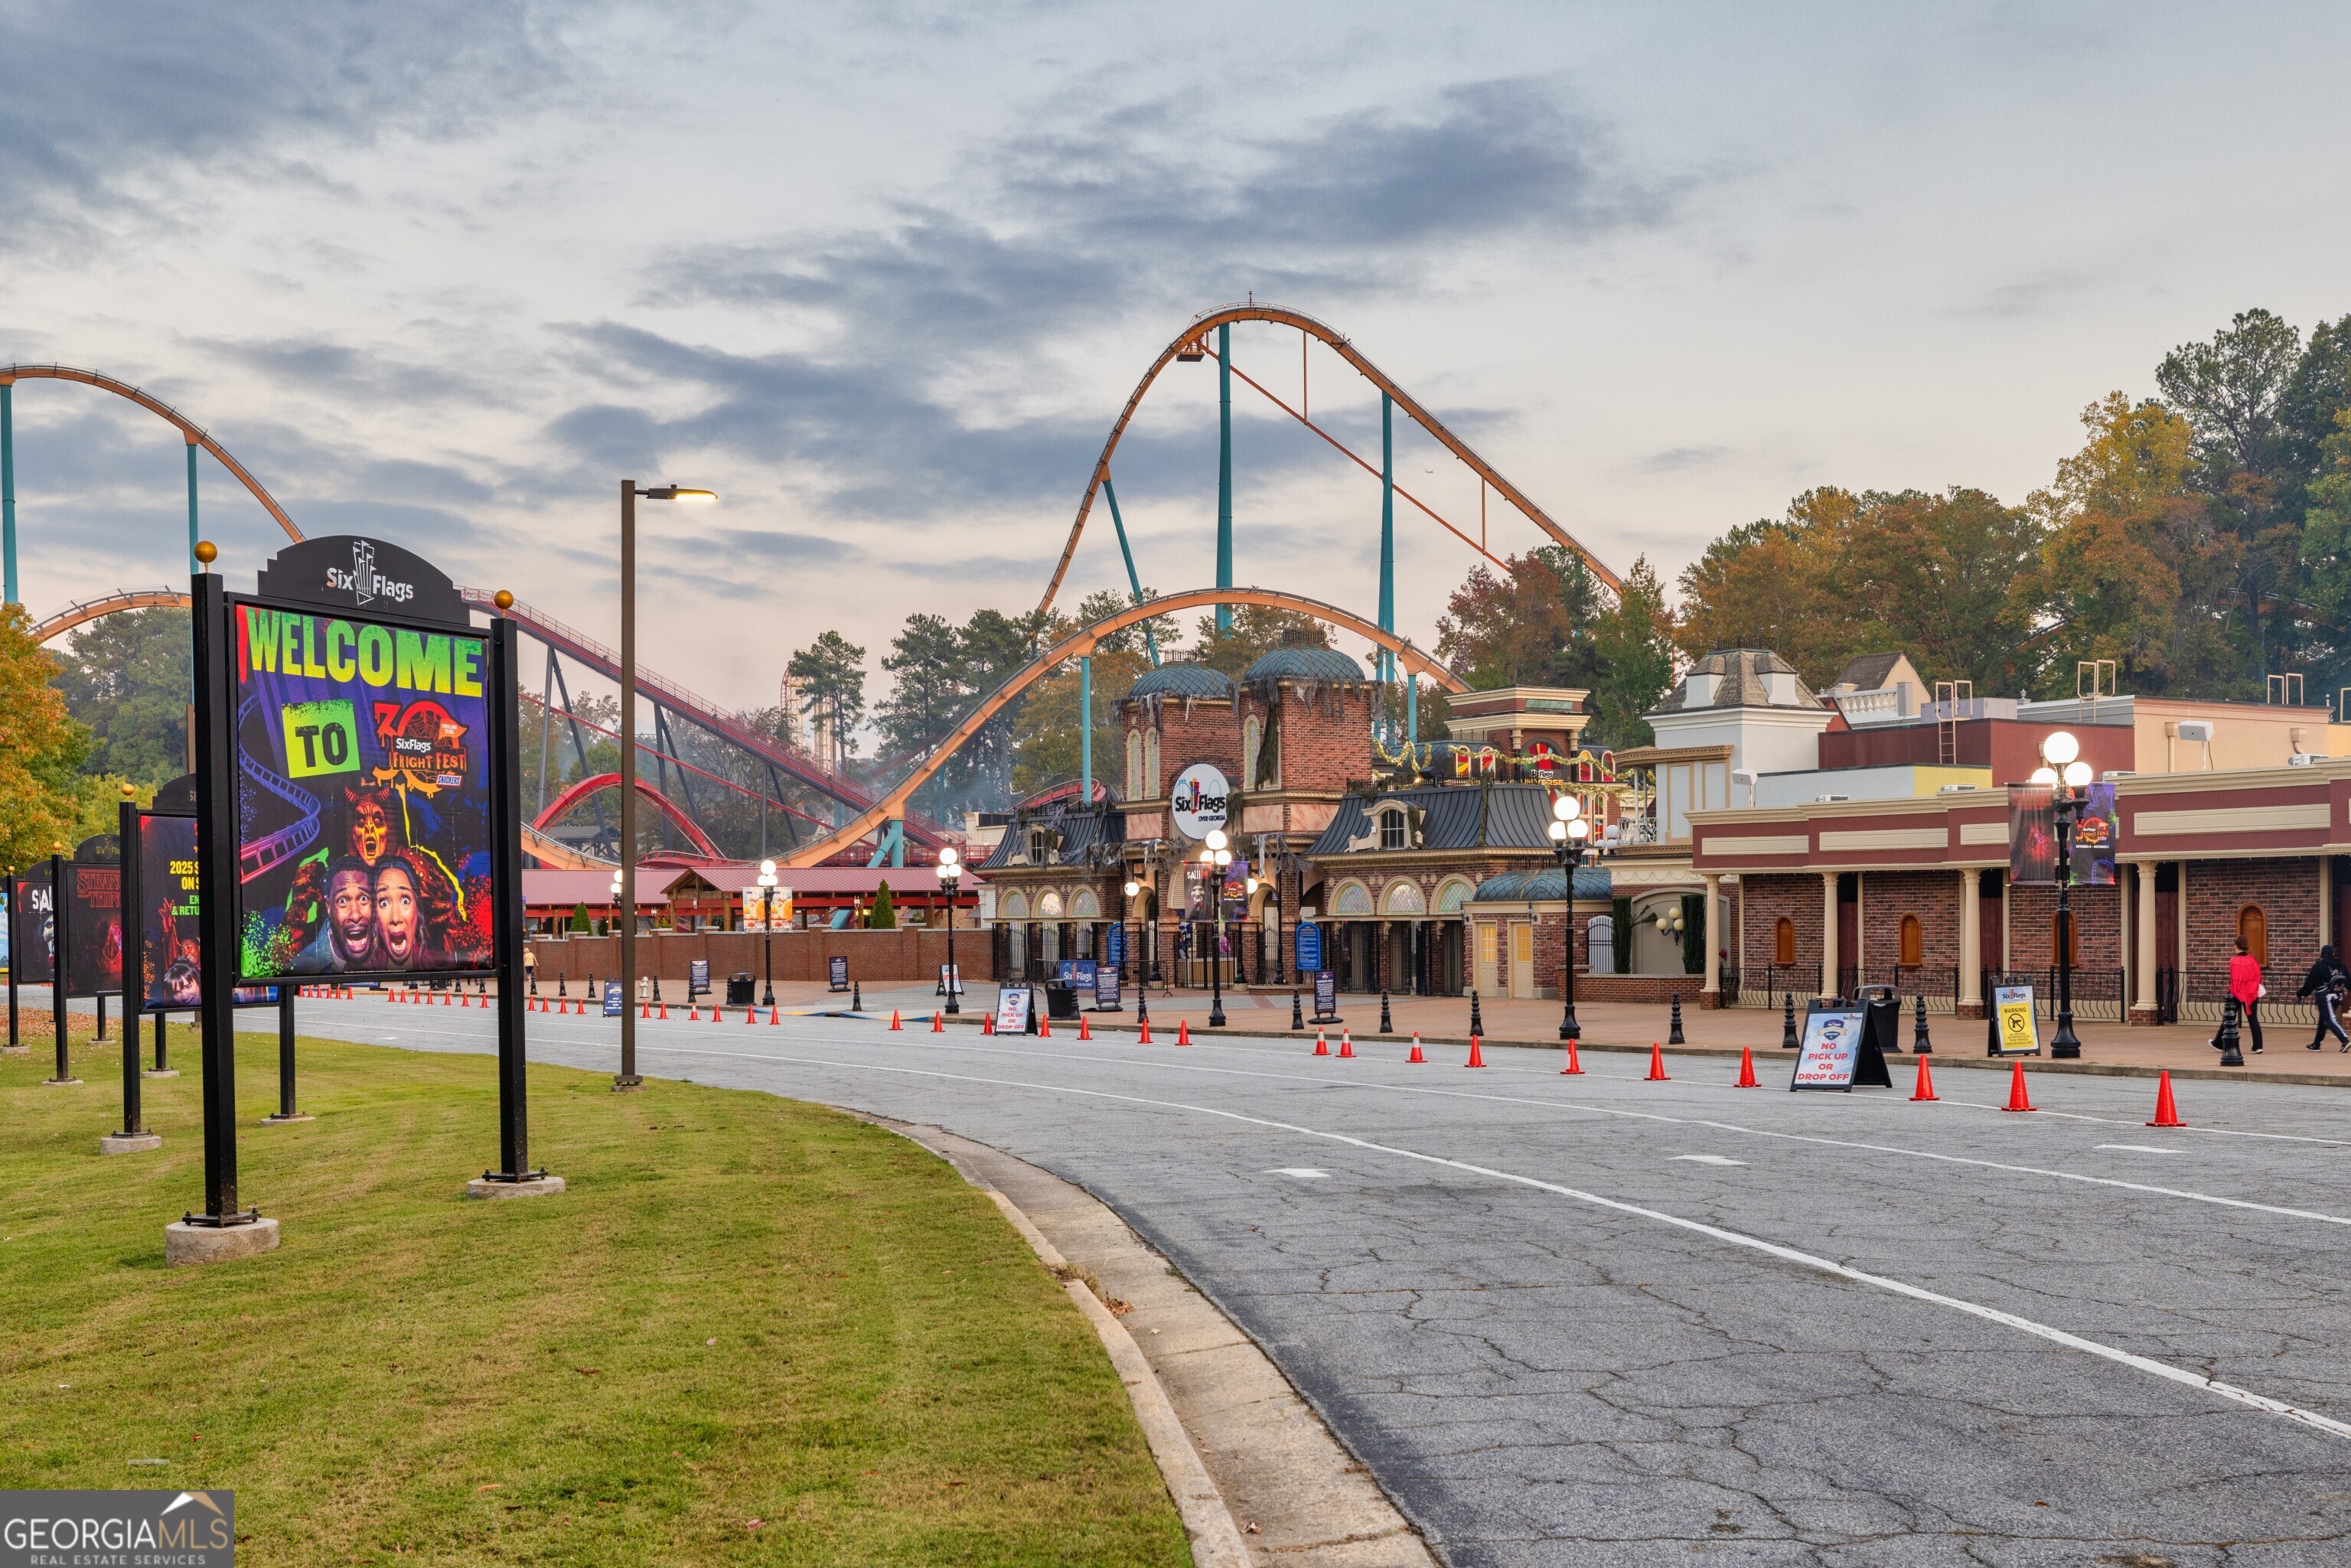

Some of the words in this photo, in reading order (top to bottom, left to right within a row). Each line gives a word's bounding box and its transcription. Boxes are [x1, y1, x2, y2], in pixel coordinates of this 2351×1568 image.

[326, 567, 354, 590] Six
[373, 574, 413, 602] Flags
[246, 607, 482, 698] WELCOME
[295, 722, 348, 768] TO
[393, 751, 433, 768] FRIGHT
[435, 752, 465, 770] FEST
[437, 775, 461, 785] SNICKERS
[1175, 796, 1192, 812] Six
[1198, 794, 1226, 813] Flags
[96, 846, 105, 855] Six
[111, 846, 120, 855] Fla
[170, 860, 194, 875] 2025
[77, 872, 121, 894] STRAN
[181, 876, 194, 890] ON
[32, 885, 54, 911] SA
[88, 891, 121, 908] THIN
[171, 905, 178, 916] &
[179, 905, 200, 915] RETU
[1076, 972, 1092, 982] Flags
